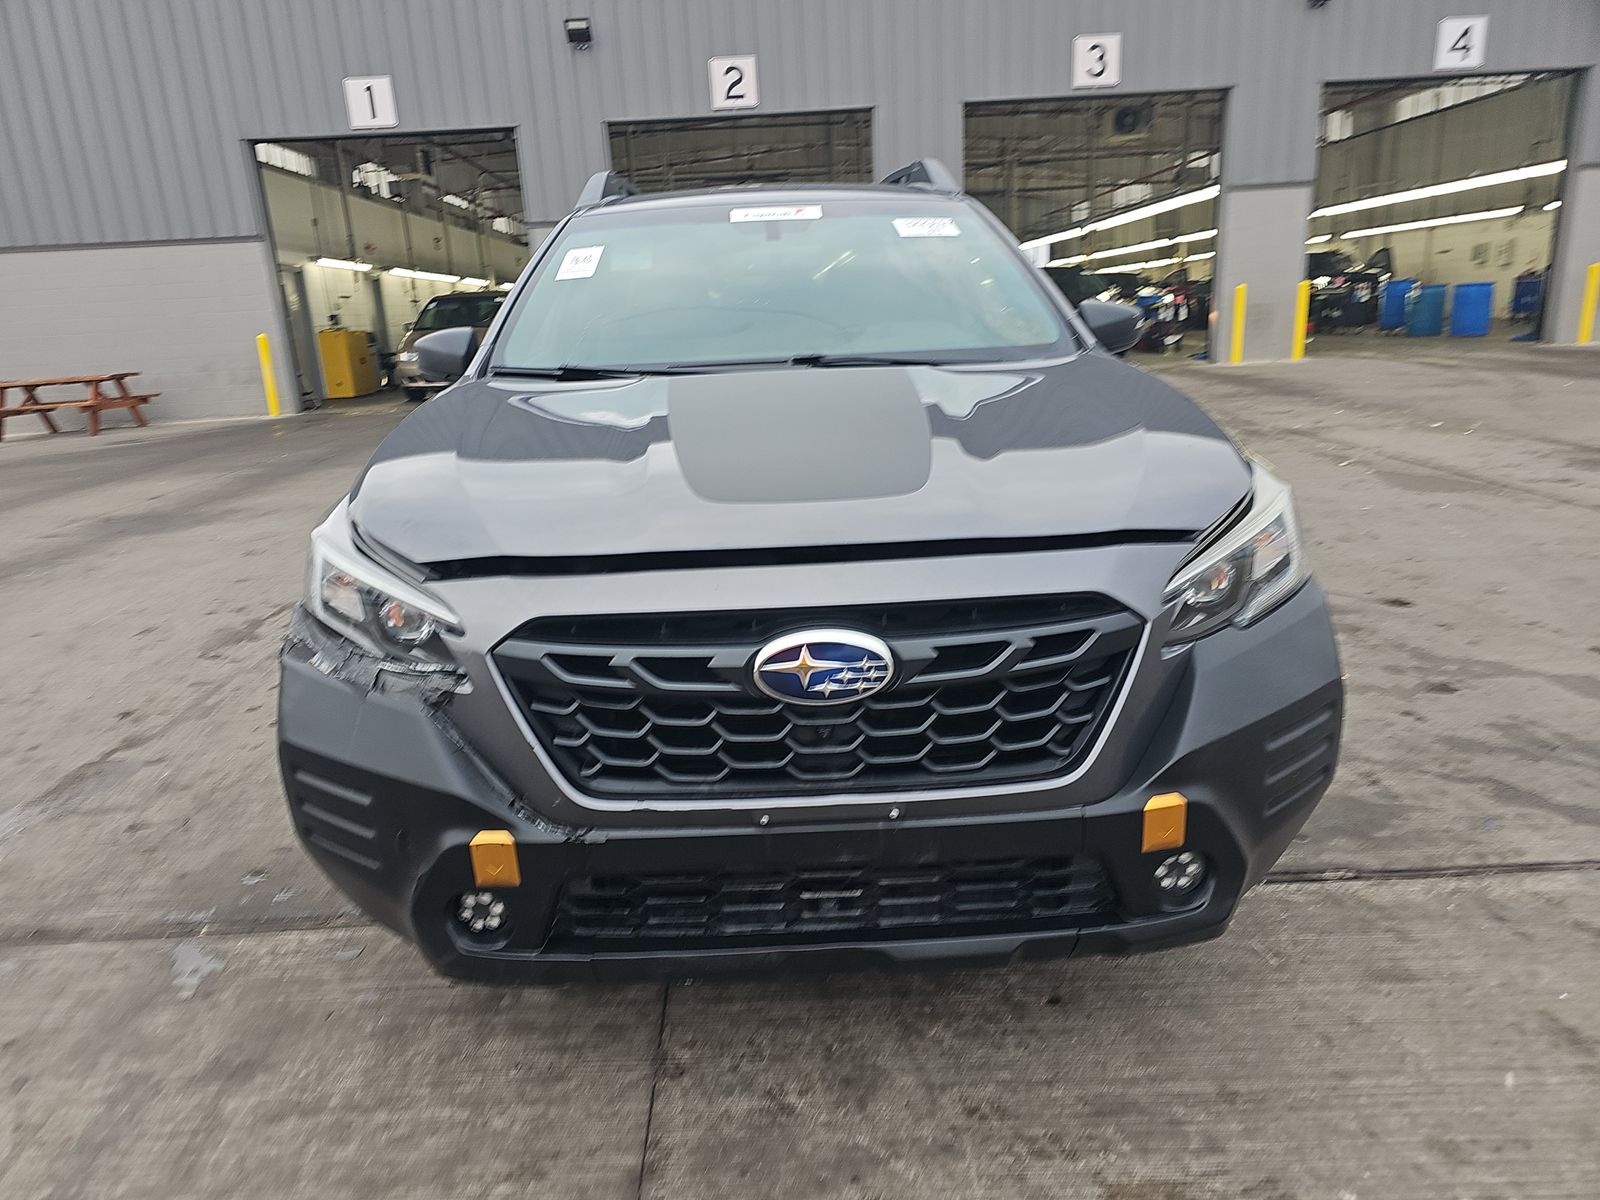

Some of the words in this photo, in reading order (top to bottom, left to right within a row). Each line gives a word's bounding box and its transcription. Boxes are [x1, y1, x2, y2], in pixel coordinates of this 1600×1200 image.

[1448, 25, 1473, 62] 4
[1086, 44, 1106, 78] 3
[724, 66, 745, 100] 2
[363, 85, 377, 119] 1
